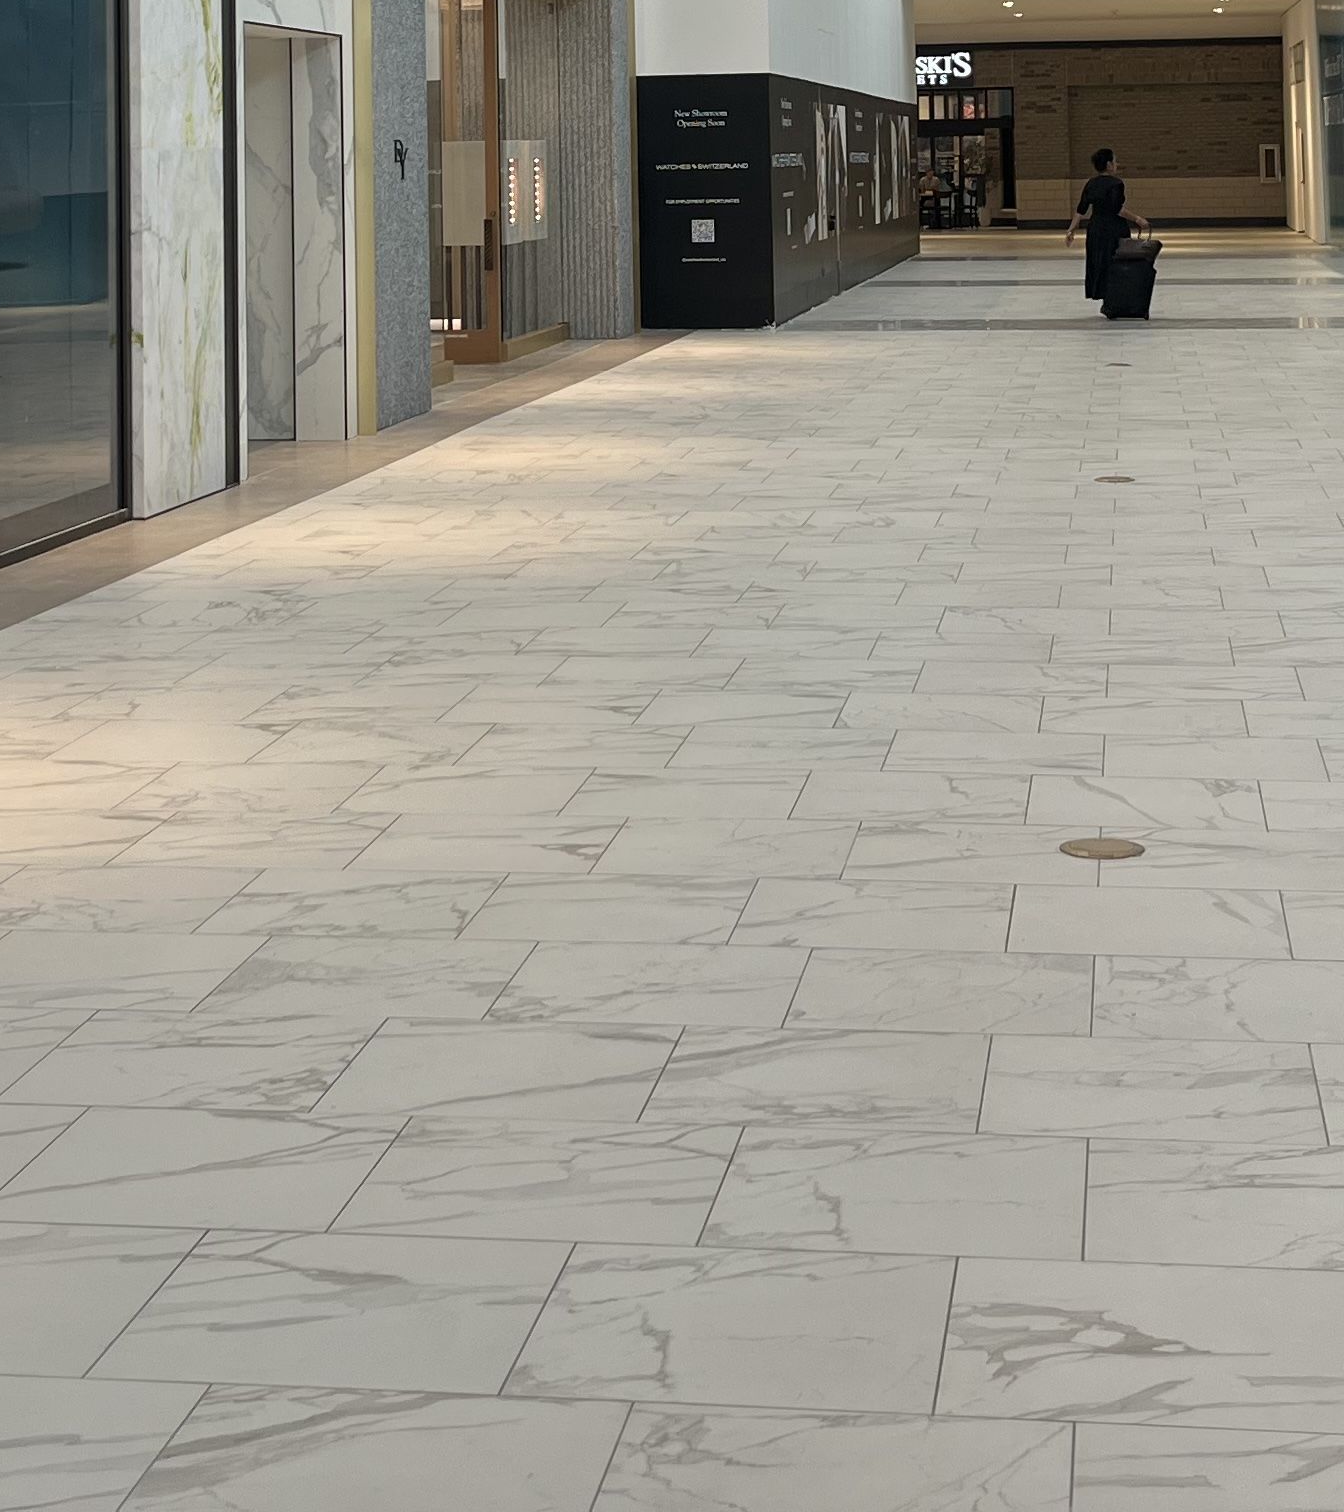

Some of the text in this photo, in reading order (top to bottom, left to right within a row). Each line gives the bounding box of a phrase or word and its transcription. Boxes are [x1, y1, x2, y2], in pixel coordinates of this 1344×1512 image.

[674, 109, 690, 118] New
[676, 118, 726, 128] Opening Soon
